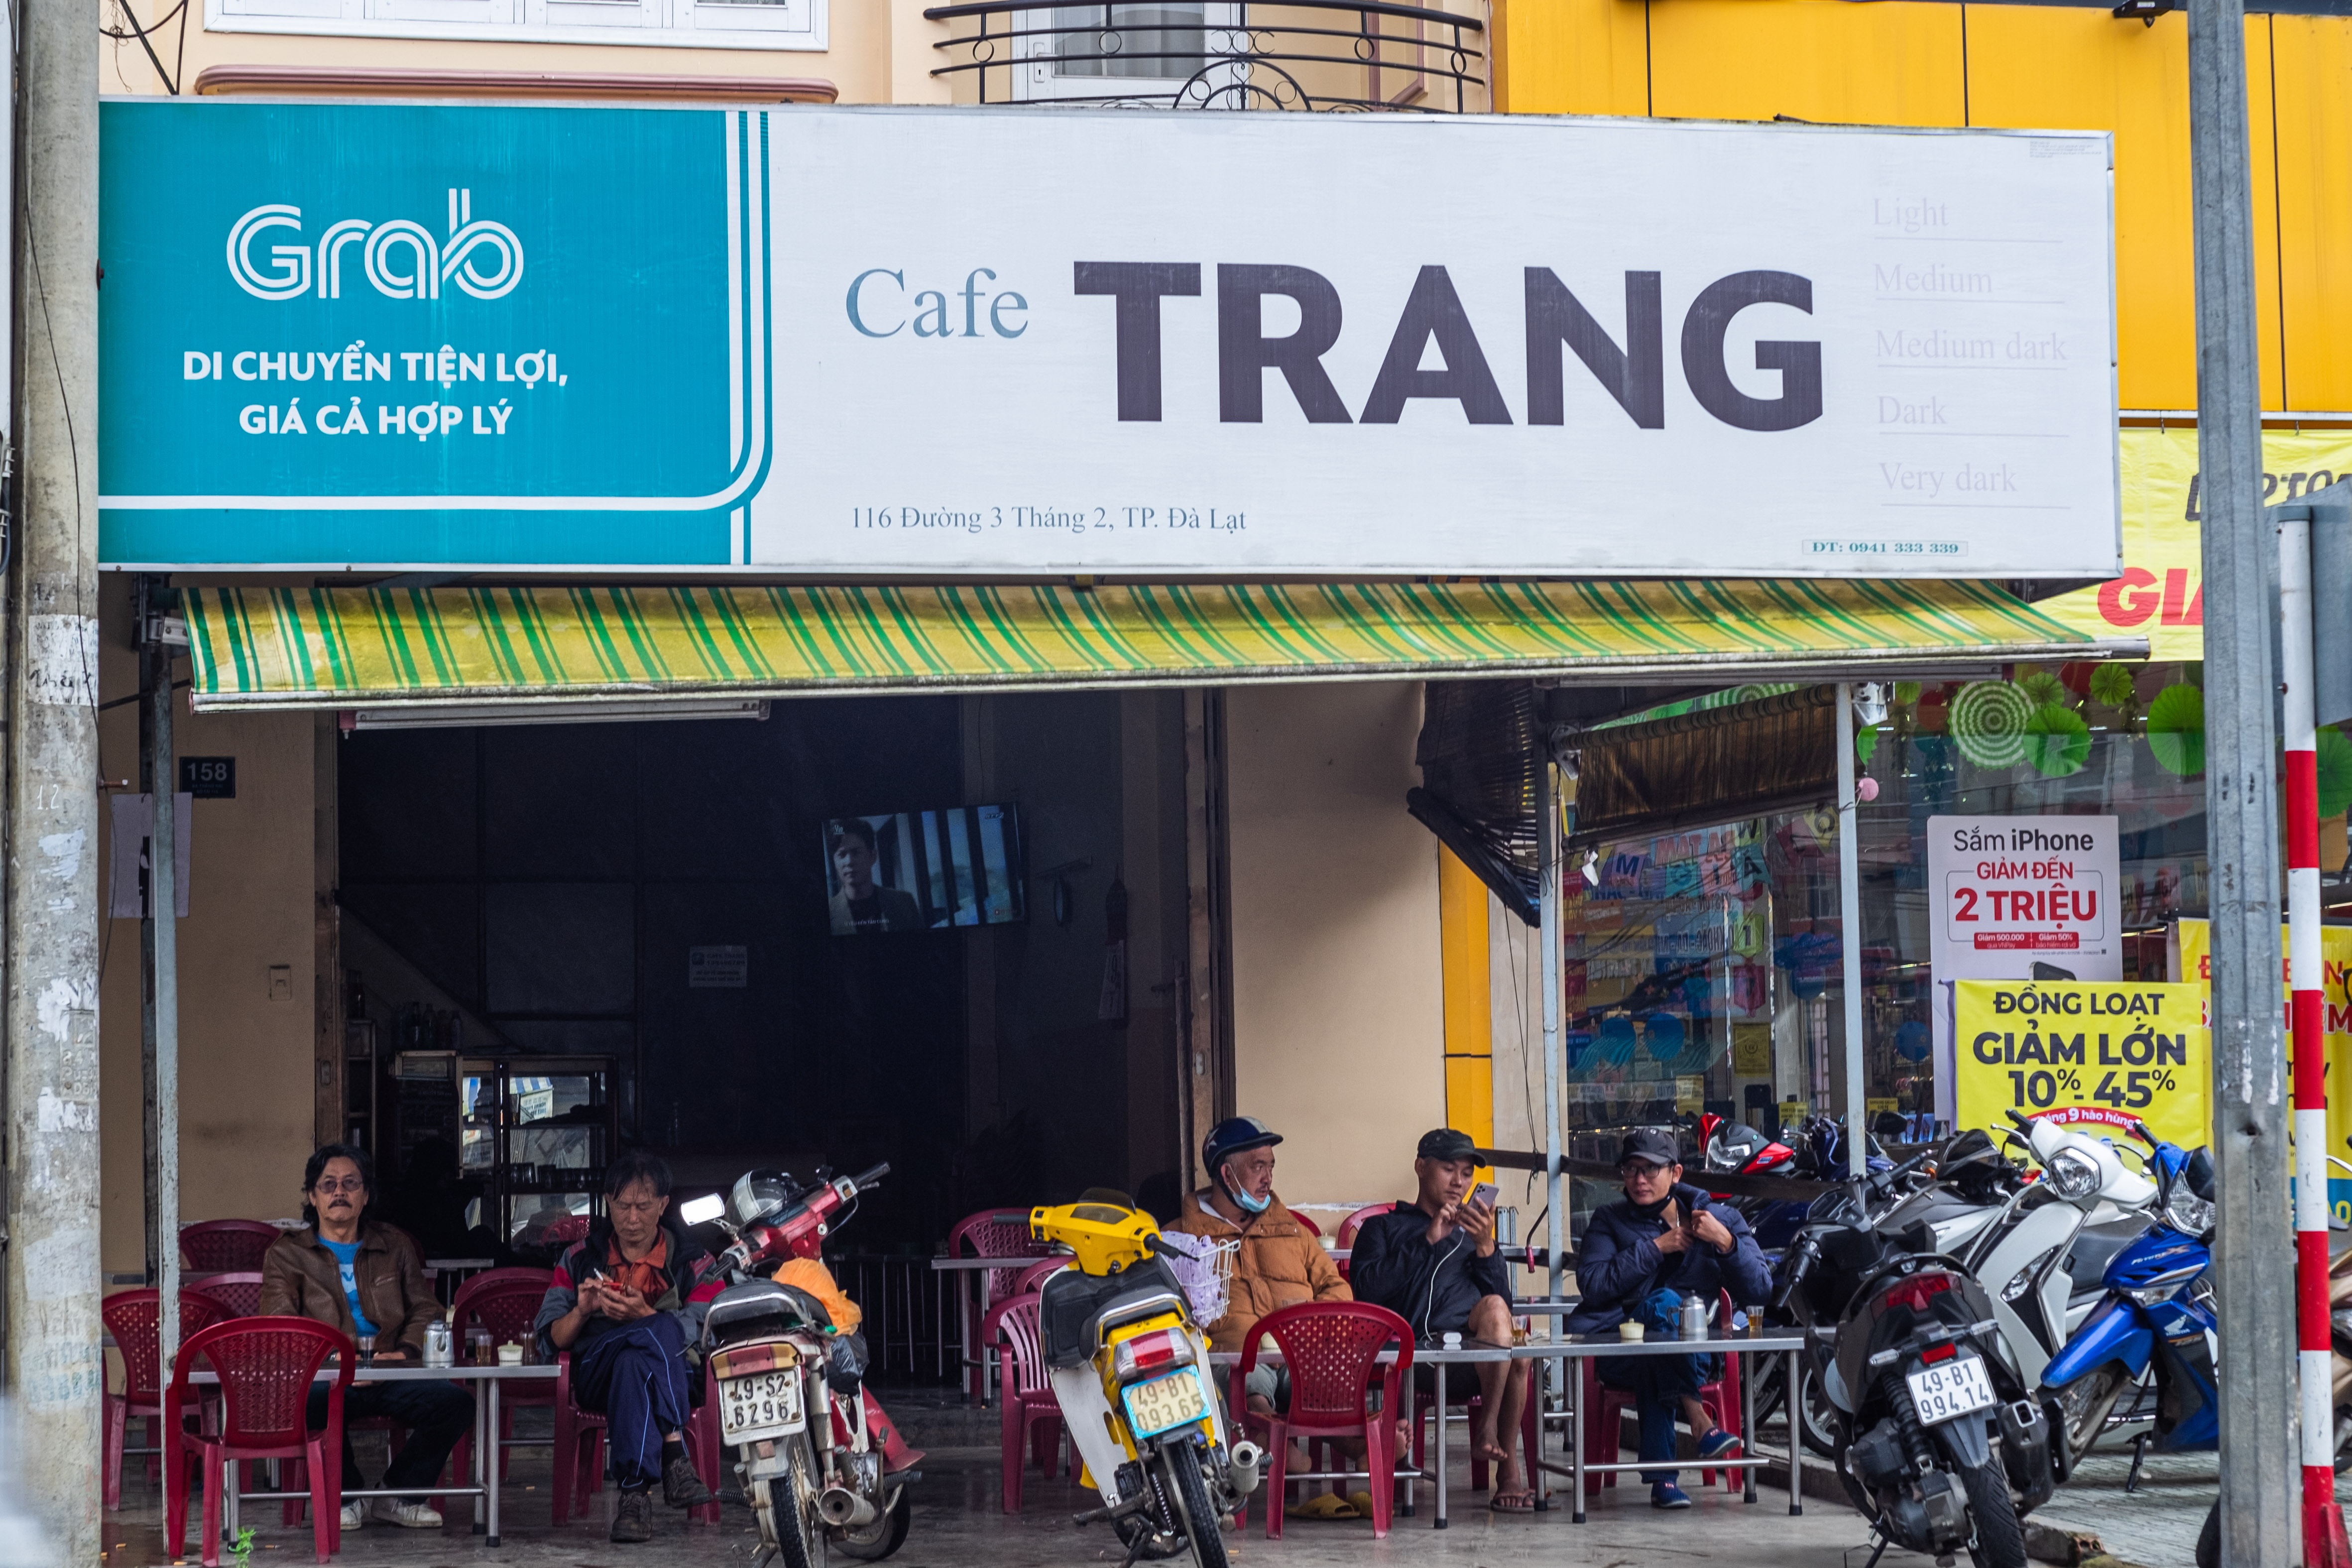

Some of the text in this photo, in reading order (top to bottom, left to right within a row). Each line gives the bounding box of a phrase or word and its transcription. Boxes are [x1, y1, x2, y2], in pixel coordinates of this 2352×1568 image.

[1874, 197, 1950, 233] Light
[226, 188, 523, 300] Grab
[1874, 263, 1993, 293] Medium
[846, 267, 1029, 339] Cafe
[1074, 261, 1823, 432] TRANG
[1876, 329, 2069, 361] Medium dark
[184, 340, 568, 389] DI CHUYỂN TIỆN LỢI,
[239, 396, 513, 442] GIÁ CẢ HỢP LÝ
[1878, 395, 1947, 425] Dark
[1879, 462, 2018, 498] Very dark
[852, 506, 1246, 535] 116 Đường 3 Tháng 2, TP. Đà Lạt
[1849, 542, 1887, 554] 0941
[1894, 542, 1923, 554] 333
[1929, 542, 1959, 554] 339
[187, 762, 228, 782] 158
[1954, 826, 2094, 851] Sắm iPhone
[1977, 854, 2074, 880] GIẢM ĐẾN
[1954, 887, 1980, 922] 2
[1986, 882, 2097, 930] TRIỆU
[1993, 983, 2165, 1021] ĐỒNG LOẠT
[1973, 1019, 2186, 1066] GIẢM LỚN
[2093, 1069, 2176, 1108] 45%
[2068, 1107, 2080, 1122] 9
[2082, 1109, 2103, 1120] hào
[1138, 1373, 1189, 1408] 49-B1
[1922, 1362, 1974, 1394] 49-B1
[1136, 1393, 1204, 1433] 093.65
[1920, 1383, 1990, 1419] 994.14
